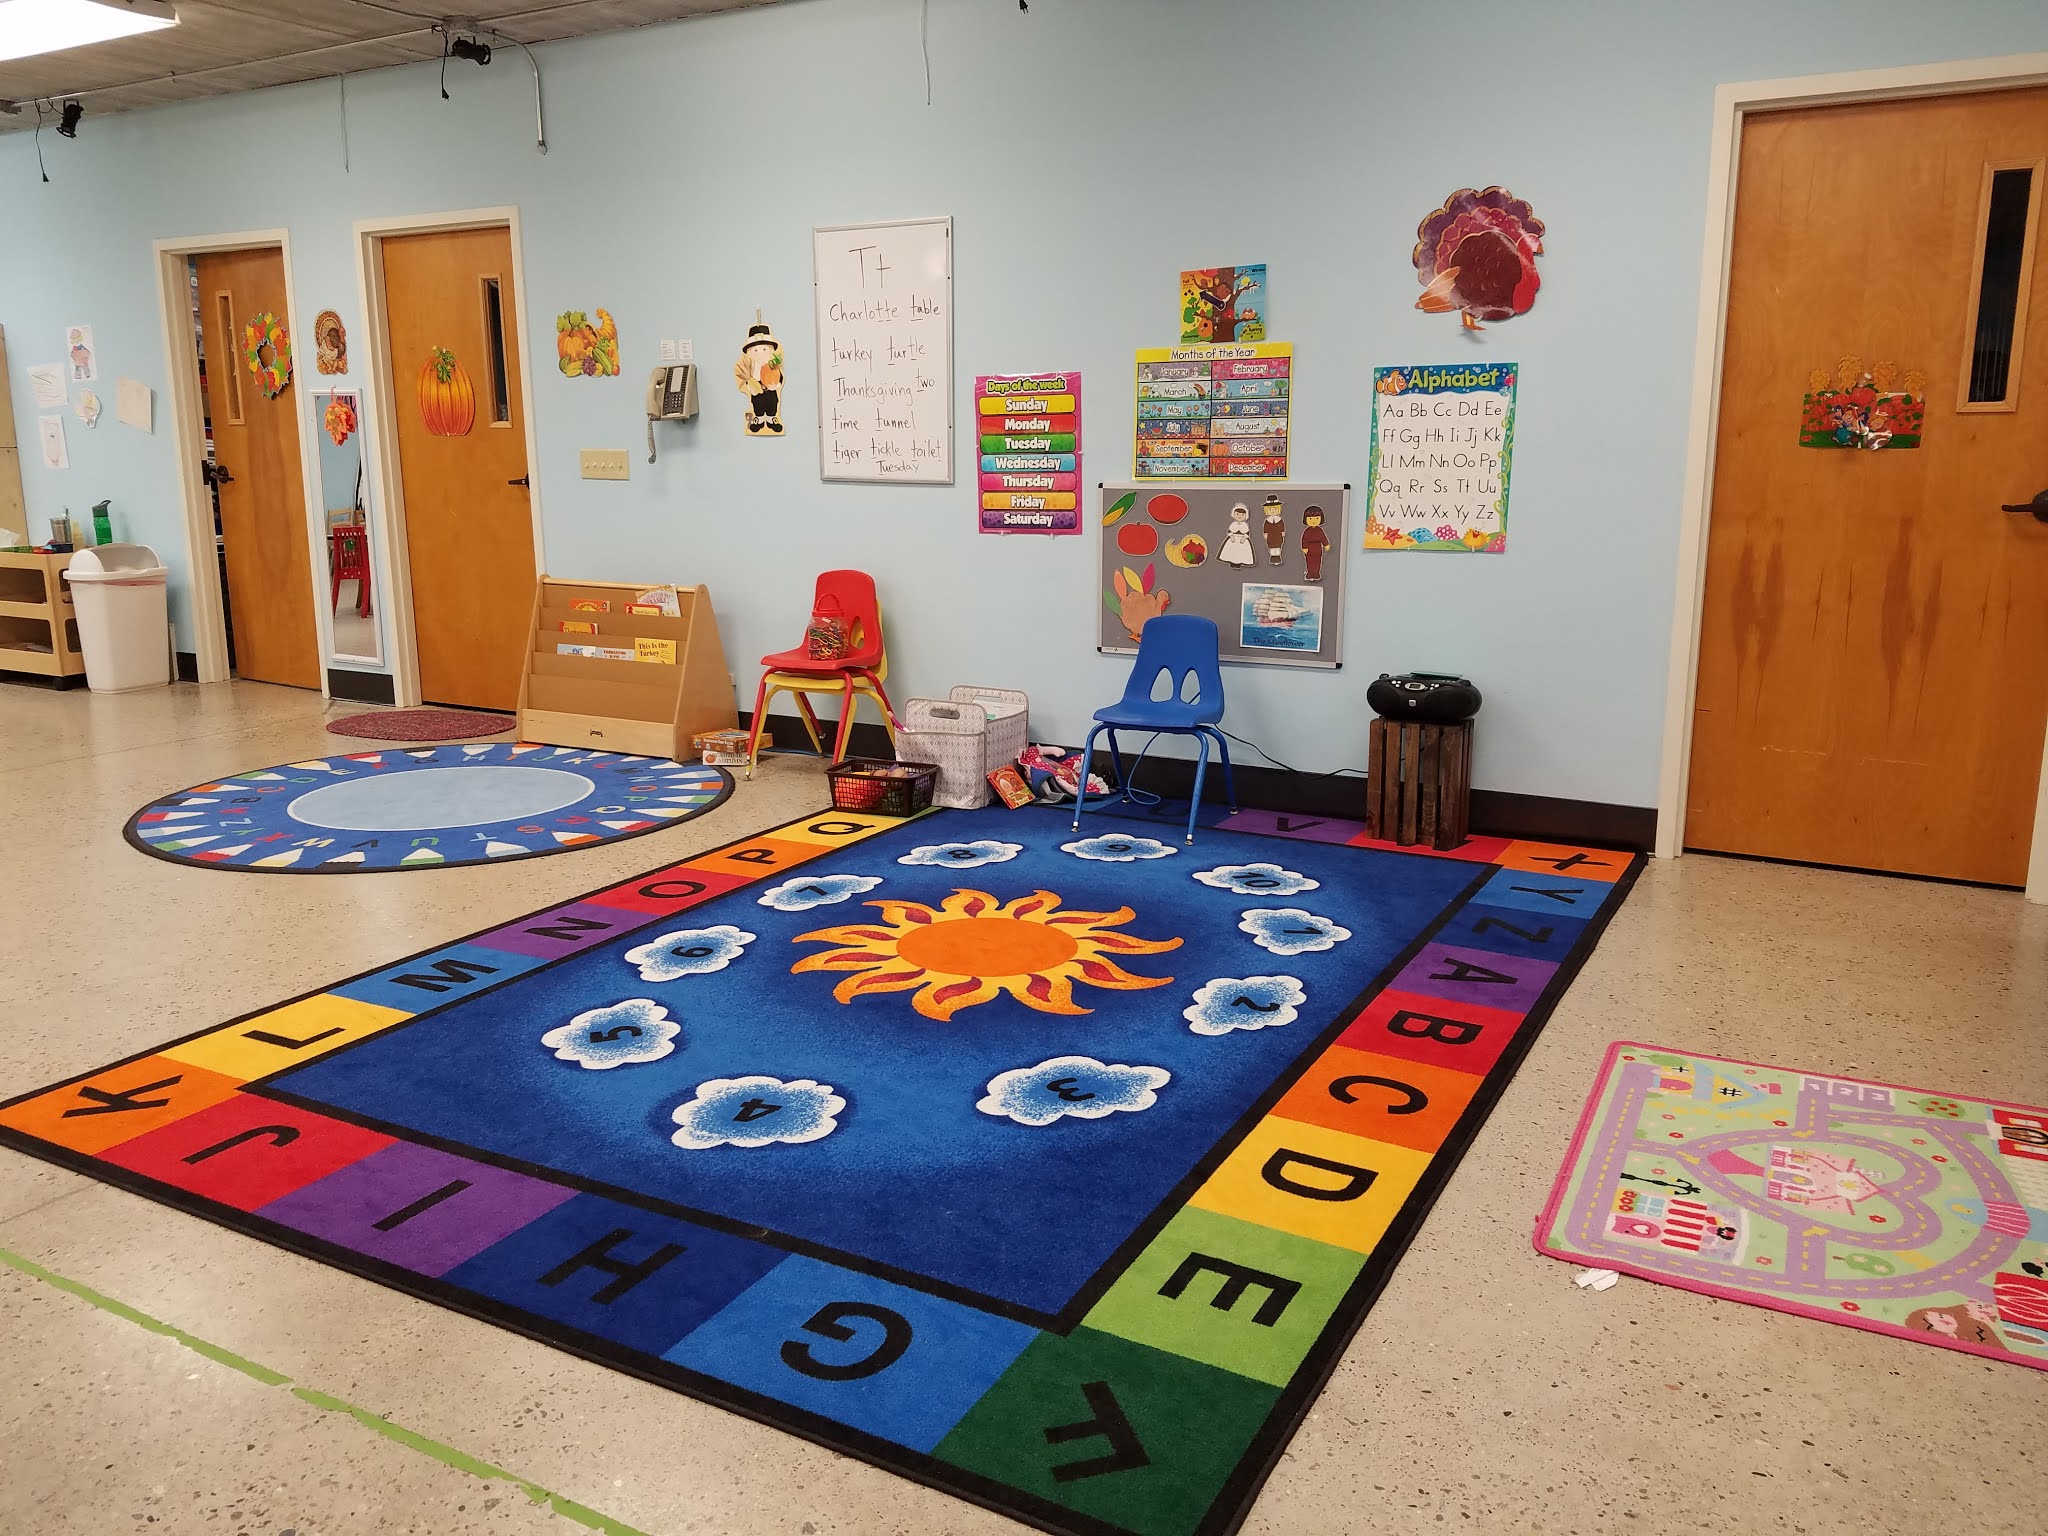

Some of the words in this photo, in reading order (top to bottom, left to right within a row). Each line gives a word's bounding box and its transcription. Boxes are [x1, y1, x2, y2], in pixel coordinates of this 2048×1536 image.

[830, 300, 900, 322] Charlotte
[910, 294, 941, 316] table
[832, 337, 872, 372] turkey
[887, 336, 926, 361] turtle
[1171, 350, 1203, 359] Months
[1206, 348, 1216, 358] of
[1219, 349, 1233, 357] the
[1235, 348, 1255, 357] Year
[1160, 368, 1189, 376] January
[1233, 365, 1268, 374] February
[833, 377, 913, 405] Thanksgiving
[916, 368, 935, 390] two
[988, 381, 1010, 393] Days
[1011, 380, 1021, 391] of
[1022, 380, 1038, 390] the
[1039, 378, 1065, 390] week
[1408, 369, 1500, 392] Alphabet
[1241, 384, 1257, 395] April
[1006, 398, 1048, 413] Sunday
[1167, 406, 1182, 415] May
[1383, 404, 1403, 418] Aa
[1410, 403, 1427, 417] Bb
[1433, 403, 1451, 416] Cc
[1459, 402, 1478, 416] Dd
[1485, 401, 1501, 415] Ee
[832, 408, 861, 431] time
[875, 408, 916, 431] tunnel
[1005, 418, 1050, 432] Monday
[1166, 424, 1180, 432] July
[1236, 423, 1260, 431] August
[1005, 438, 1051, 451] Tuesday
[1383, 429, 1396, 443] Ff
[1400, 429, 1420, 449] Gg
[1425, 429, 1444, 442] Hh
[1450, 428, 1459, 442] Ii
[1465, 428, 1477, 448] Jj
[1484, 427, 1501, 442] Kk
[833, 440, 862, 464] tiger
[870, 438, 902, 458] tickle
[911, 440, 942, 459] toilet
[1156, 445, 1192, 453] September
[1233, 444, 1265, 452] October
[877, 461, 920, 475] Tuesday
[995, 457, 1061, 471] Wednesday
[1382, 455, 1393, 468] Ll
[1400, 455, 1425, 468] Mm
[1430, 454, 1449, 467] Nn
[1453, 454, 1475, 467] Oo
[1480, 453, 1496, 474] Pp
[1002, 475, 1054, 489] Thursday
[1380, 479, 1402, 498] Qq
[1410, 479, 1424, 493] Rr
[1434, 479, 1447, 493] Ss
[1457, 479, 1469, 493] Tt
[1478, 479, 1496, 493] Uu
[1011, 495, 1045, 509] Friday
[1004, 513, 1053, 527] Saturday
[1379, 505, 1395, 518] Vv
[1400, 505, 1426, 518] Ww
[1432, 505, 1448, 518] Xx
[1455, 505, 1469, 524] Yy
[1476, 505, 1493, 519] Zz
[1268, 638, 1305, 646] Mayflower
[589, 805, 626, 813] Q
[809, 822, 876, 836] Q
[1277, 817, 1325, 832] V
[256, 832, 294, 842] X
[291, 837, 335, 848] W
[351, 839, 379, 848] V
[411, 837, 439, 846] U
[470, 833, 498, 842] T
[733, 847, 795, 866] P
[946, 848, 977, 859] 8
[1529, 853, 1608, 871] X
[1230, 874, 1284, 886] 10
[639, 880, 707, 902] O
[797, 886, 831, 898] 7
[1509, 885, 1585, 904] Y
[523, 916, 613, 941] N
[1283, 926, 1320, 938] 1
[1472, 916, 1555, 942] Z
[670, 945, 713, 958] 6
[389, 959, 500, 992] M
[1432, 957, 1518, 985] A
[1231, 994, 1281, 1014] 2
[591, 1024, 643, 1044] 5
[1386, 1009, 1484, 1046] B
[241, 1026, 345, 1050] L
[63, 1073, 183, 1119] K
[1046, 1077, 1095, 1101] 3
[1328, 1075, 1429, 1115] C
[733, 1098, 782, 1123] 4
[183, 1125, 298, 1164] J
[1261, 1147, 1380, 1202] D
[373, 1180, 473, 1231] I
[539, 1228, 687, 1305] H
[1157, 1251, 1302, 1327] E
[780, 1301, 913, 1381] G
[1046, 1381, 1150, 1483] F
